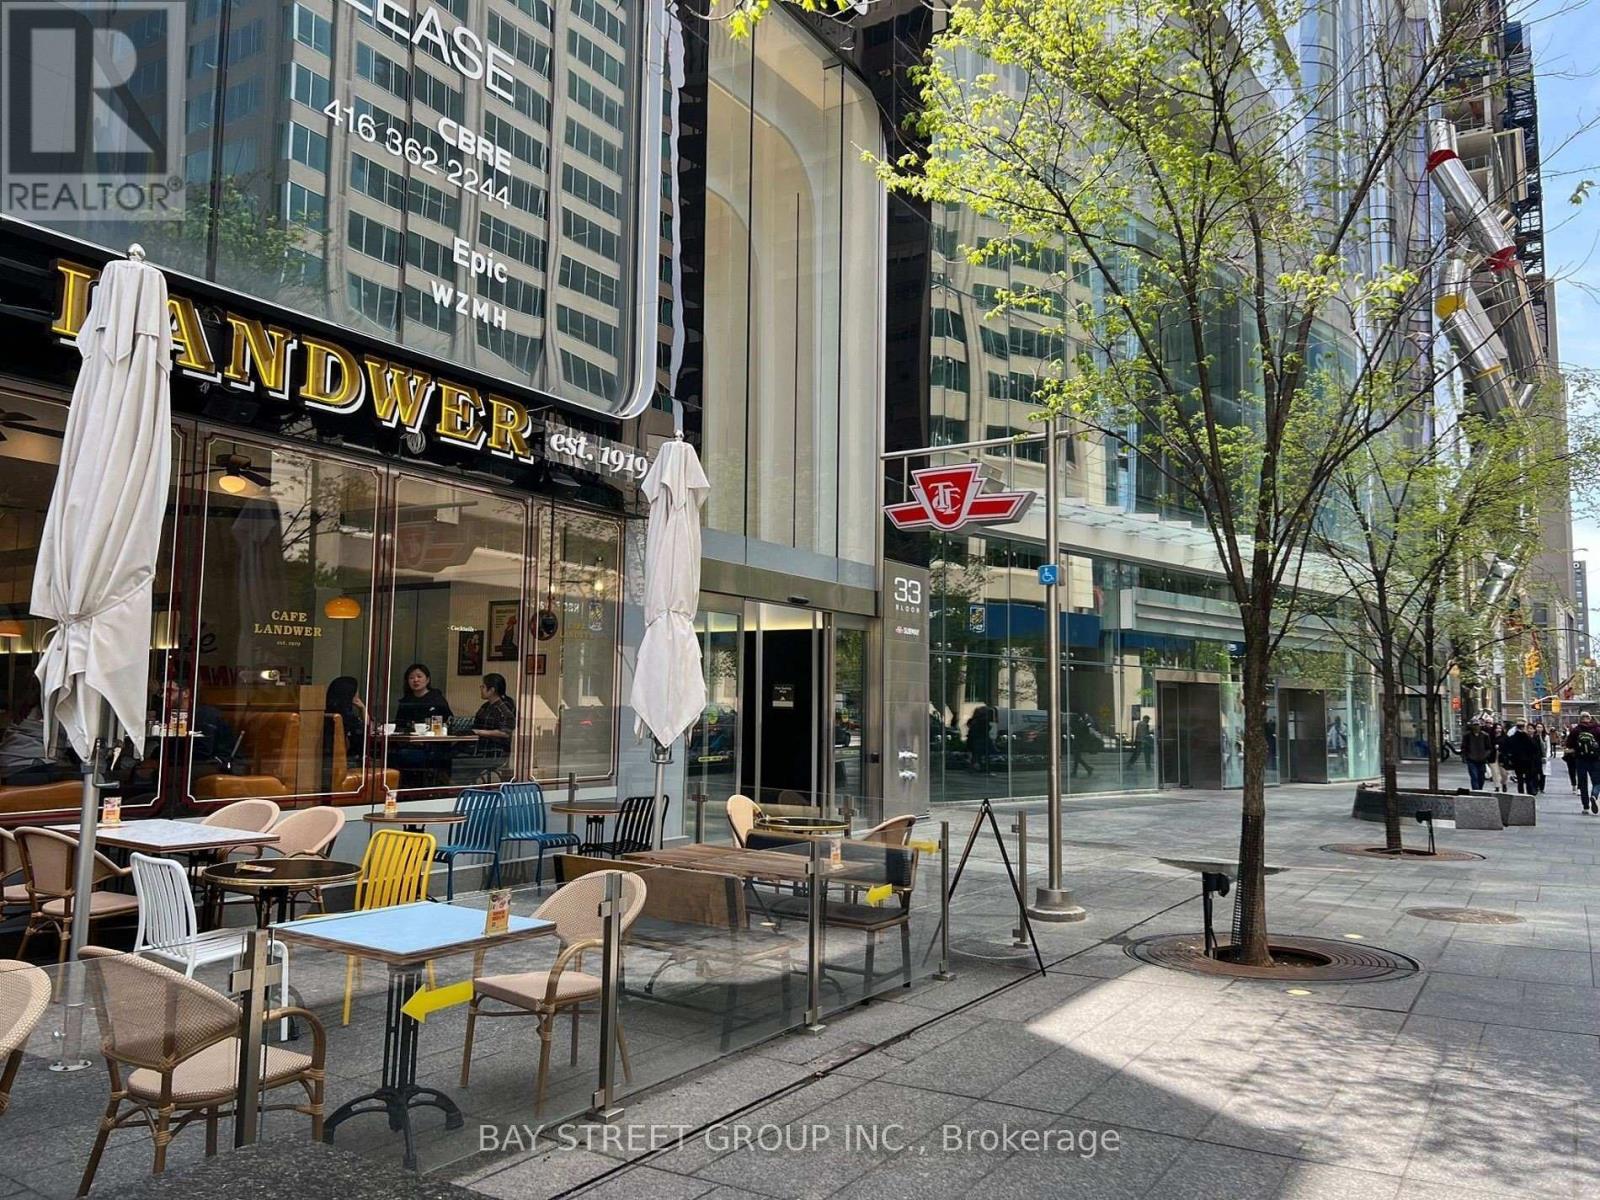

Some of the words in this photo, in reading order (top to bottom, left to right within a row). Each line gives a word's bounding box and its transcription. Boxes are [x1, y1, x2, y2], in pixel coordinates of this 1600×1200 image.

[344, 0, 515, 102] EASE
[322, 98, 377, 144] 416
[385, 127, 440, 176] 362
[447, 159, 511, 210] 2244
[437, 117, 512, 176] CBRE
[452, 236, 509, 284] Epic
[430, 280, 508, 332] WZMH
[549, 433, 594, 462] est.
[599, 445, 649, 479] 1919
[894, 576, 922, 605] 33
[254, 623, 322, 637] LANDWER
[271, 610, 308, 622] CAFE
